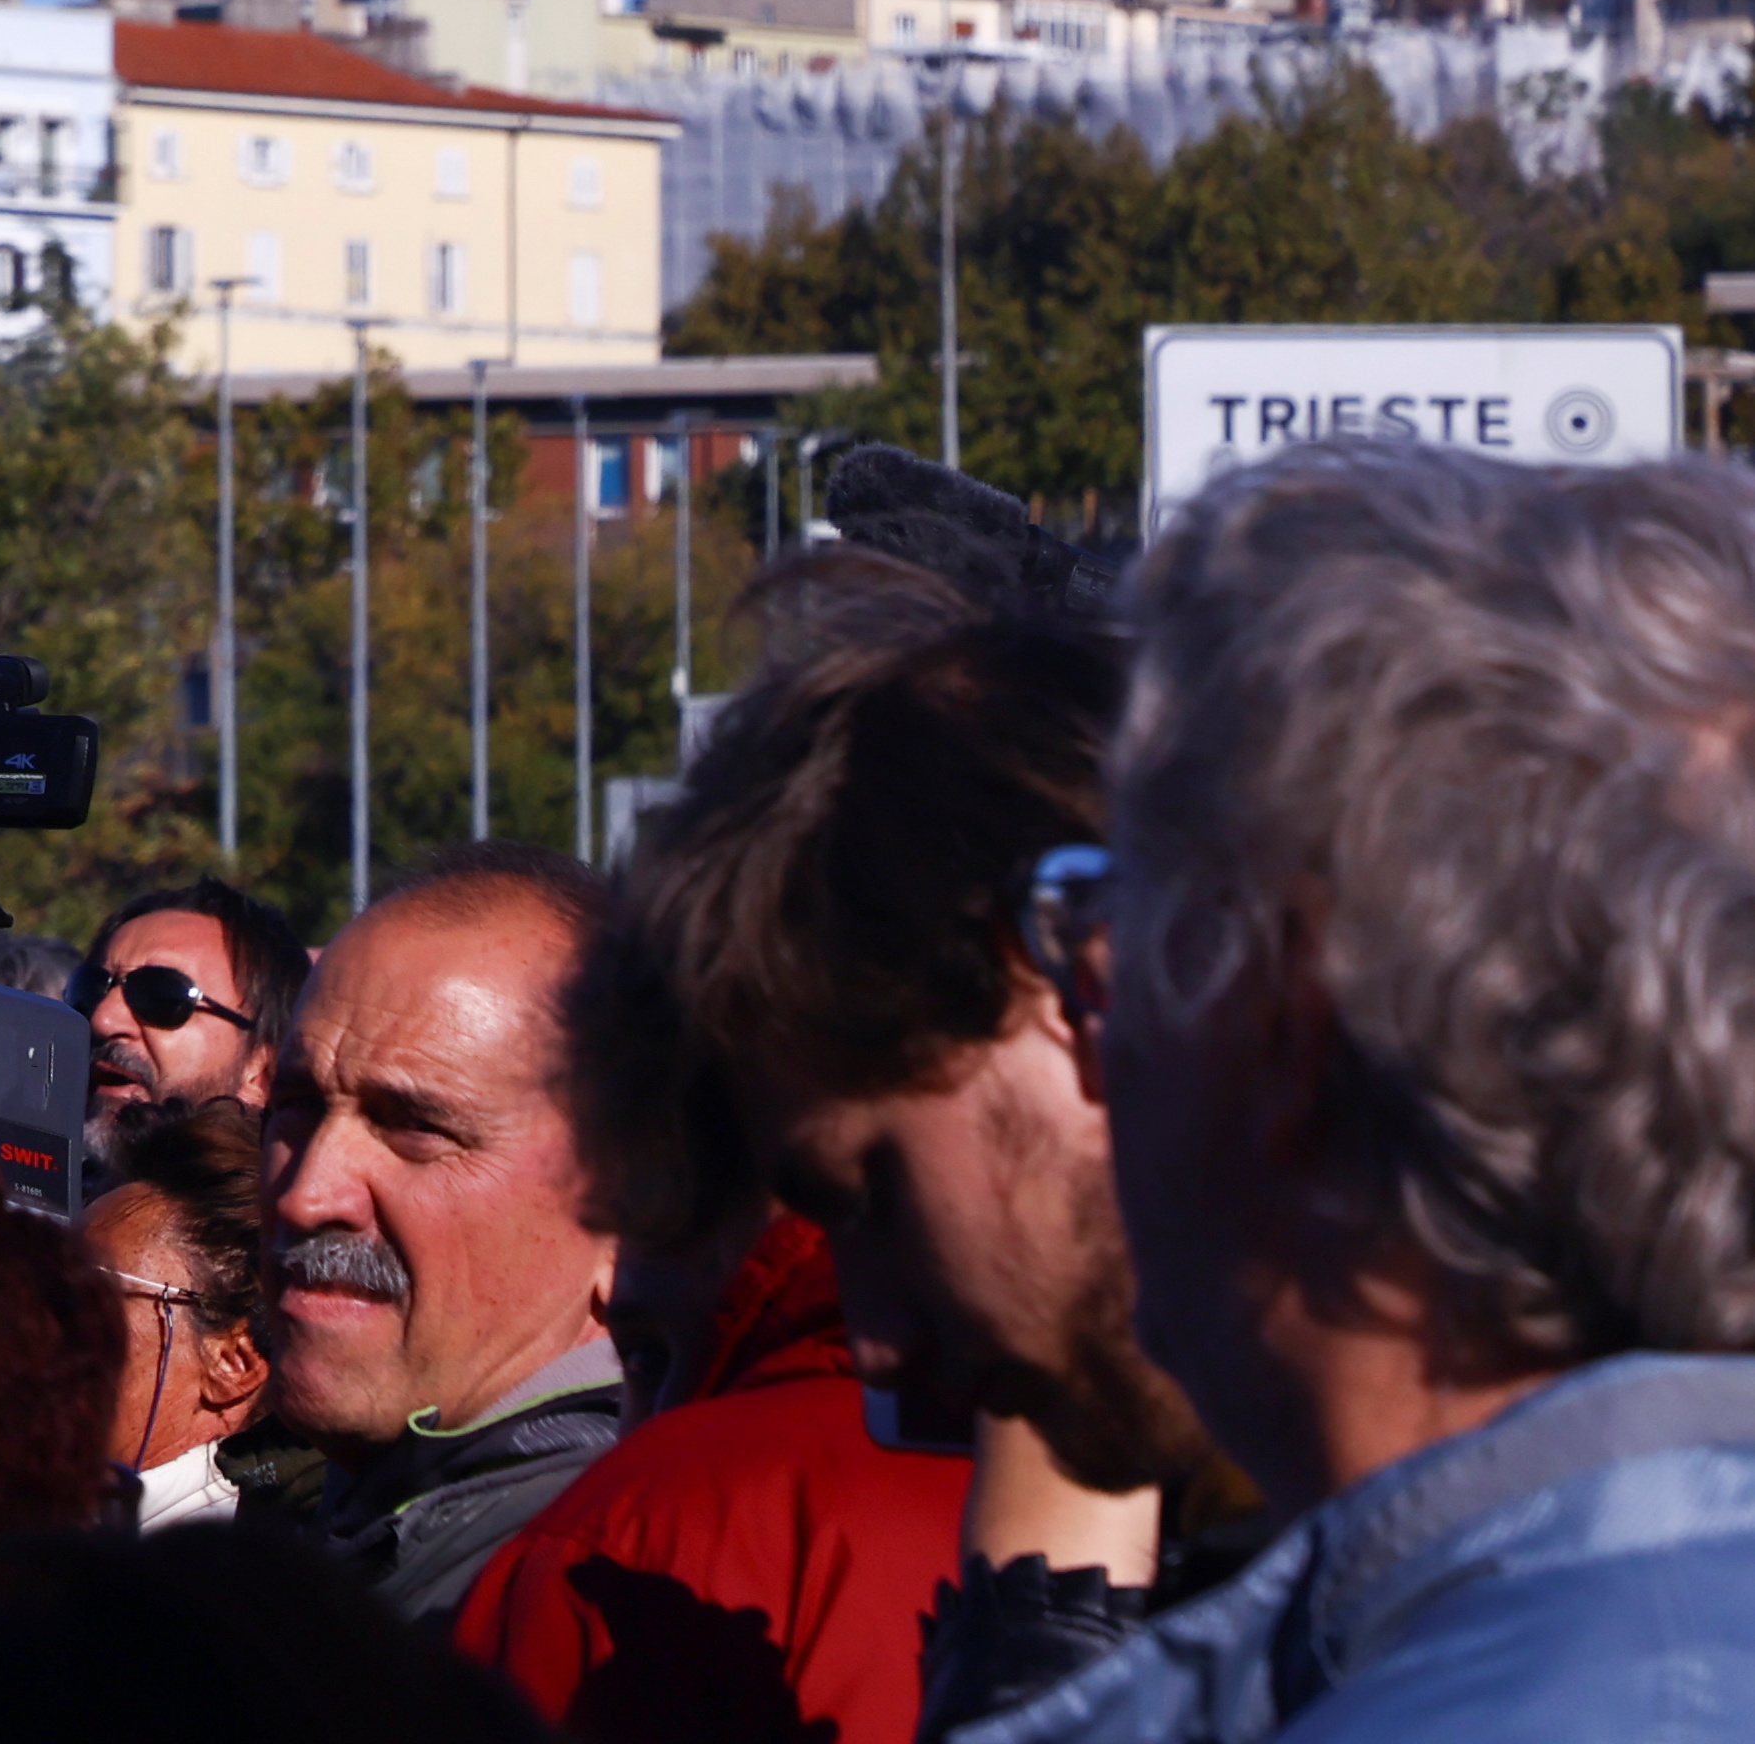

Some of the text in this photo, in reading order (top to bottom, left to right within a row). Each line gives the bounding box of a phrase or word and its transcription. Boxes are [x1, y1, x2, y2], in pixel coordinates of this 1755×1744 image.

[1210, 394, 1513, 448] TRIESTE
[4, 753, 36, 770] 4K
[0, 1142, 55, 1171] SWIT
